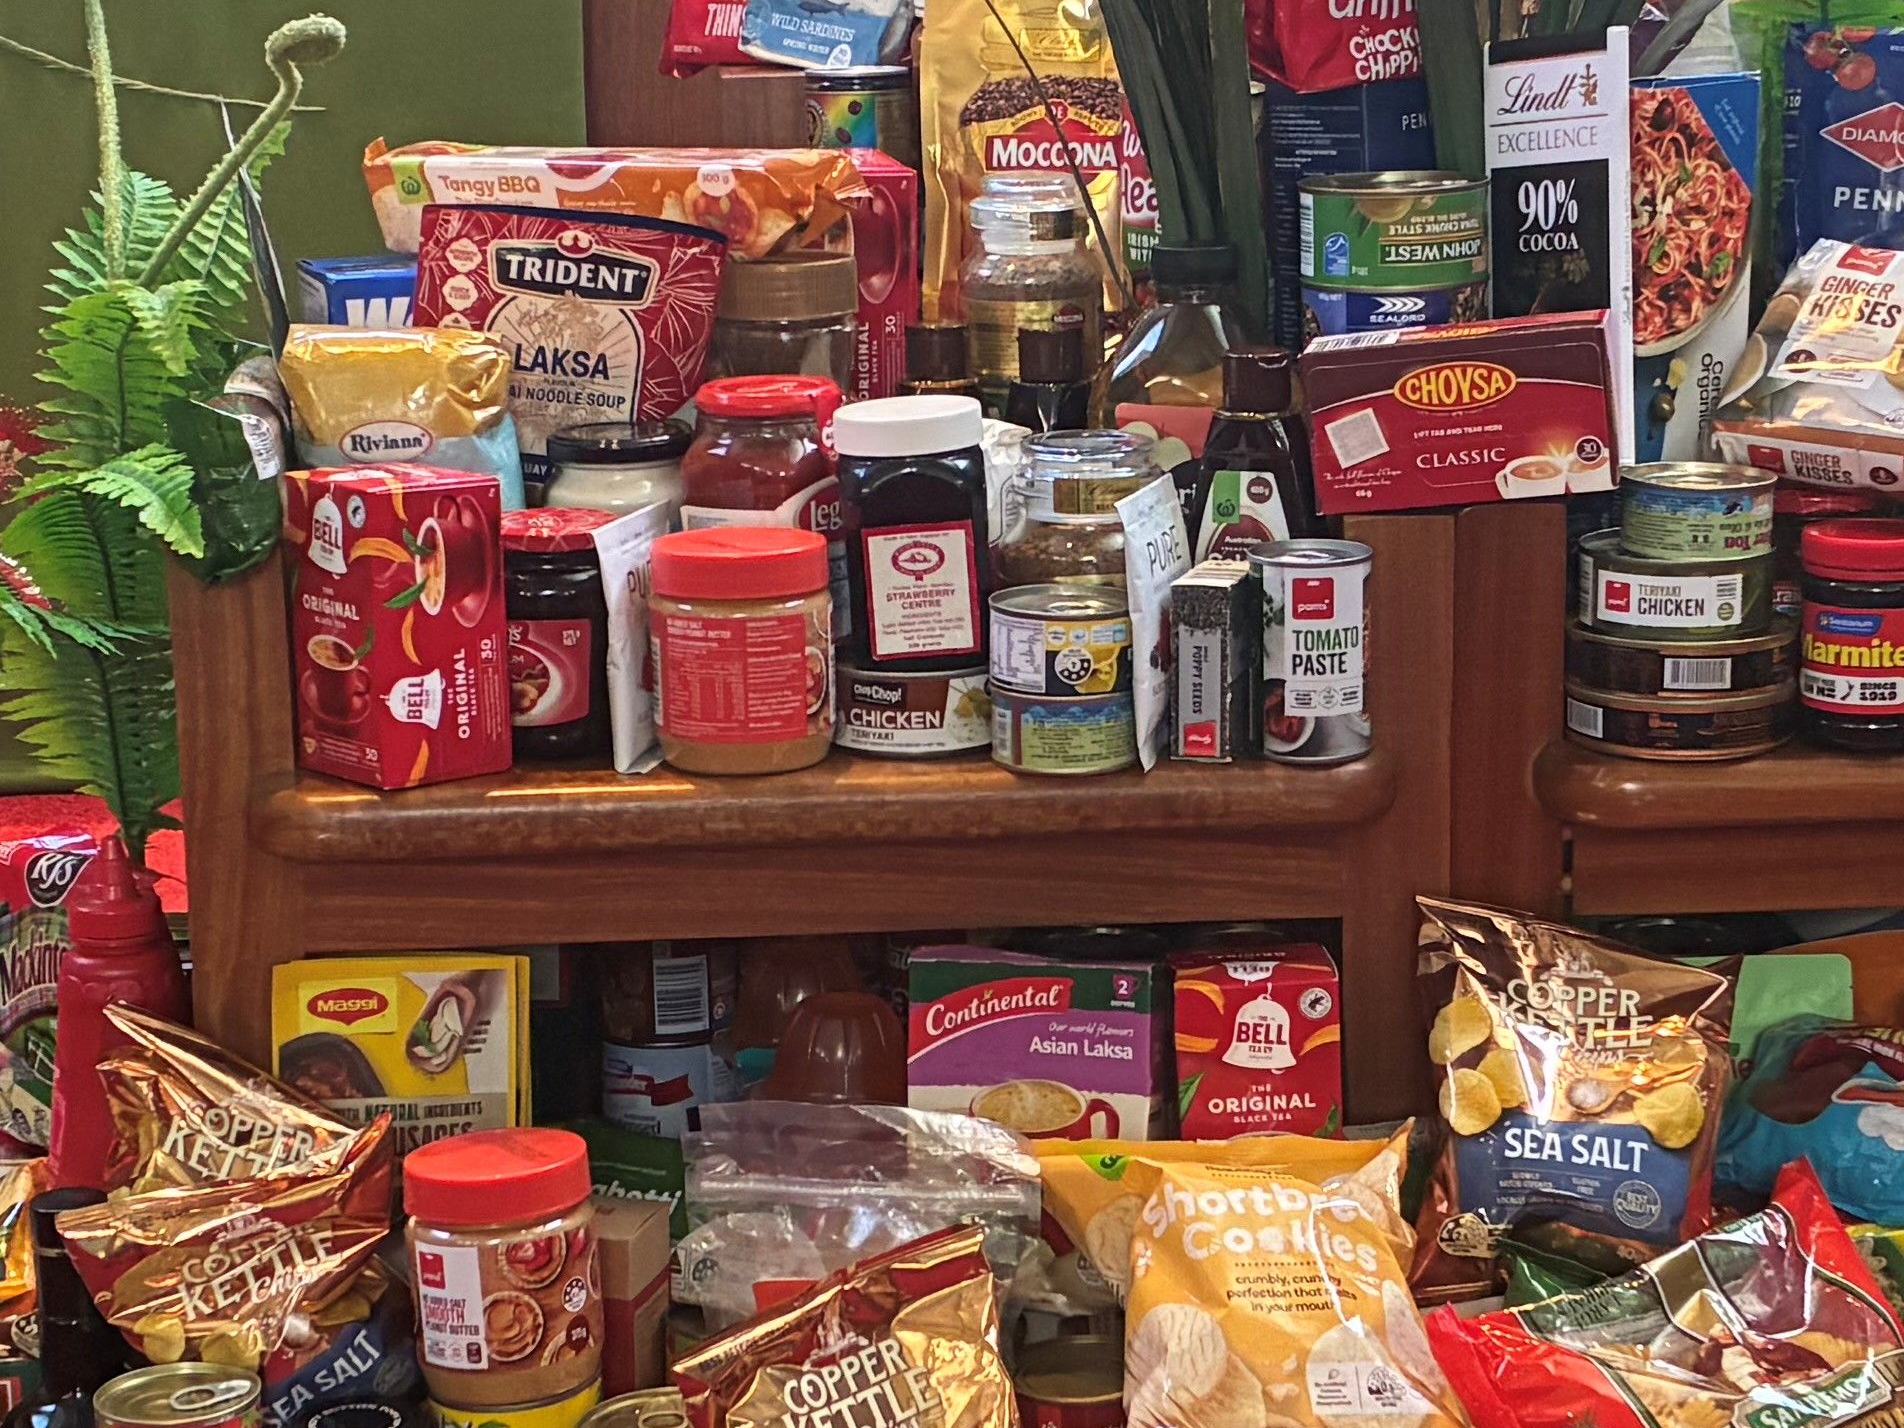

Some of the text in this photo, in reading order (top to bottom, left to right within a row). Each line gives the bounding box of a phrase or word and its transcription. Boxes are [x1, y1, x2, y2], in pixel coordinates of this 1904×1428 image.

[1496, 71, 1578, 116] Lindt
[1498, 125, 1599, 154] EXCELLENCE
[992, 138, 1118, 168] MOCCONA
[437, 175, 542, 197] Tangy BBQ
[1518, 178, 1578, 233] 90%
[1442, 239, 1482, 258] JOHN
[1519, 232, 1579, 253] COCOA
[504, 254, 639, 294] TRIDENT
[1820, 274, 1895, 300] GINGER
[1809, 293, 1902, 329] KISSES
[513, 343, 610, 380] LAKSA
[525, 387, 627, 409] NOODLE SOUP
[1405, 366, 1507, 406] CHOYSA
[350, 433, 425, 454] Riviana
[1416, 447, 1506, 469] CLASSIC
[1790, 450, 1841, 468] GINGER
[313, 518, 342, 551] BELL
[1147, 525, 1184, 578] PURE
[886, 587, 955, 602] STRAWBERRY
[1637, 583, 1682, 598] TERIYAKI
[302, 594, 360, 621] ORIGINAL
[900, 599, 942, 610] CENTRE
[1637, 597, 1705, 617] CHICKEN
[1292, 625, 1359, 652] TOMATO
[1291, 651, 1347, 676] PASTE
[406, 678, 425, 720] BELL
[453, 648, 471, 740] ORIGINAL
[1192, 680, 1203, 715] SEEDS
[849, 707, 941, 729] CHICKEN
[851, 729, 895, 741] TERIYAKI
[1117, 980, 1129, 996] 2
[1506, 977, 1641, 1018] COPPER
[925, 988, 1061, 1036] Continental
[1235, 1021, 1288, 1046] BELL
[1029, 1035, 1133, 1061] Asian Laksa
[1207, 1091, 1316, 1114] ORIGINAL
[1503, 1126, 1650, 1174] SEA SALT
[1235, 1274, 1290, 1287] crumbly,
[1226, 1287, 1323, 1301] perfection that
[1265, 1301, 1294, 1315] your
[314, 1328, 384, 1392] SALT
[782, 1336, 907, 1417] COPPER
